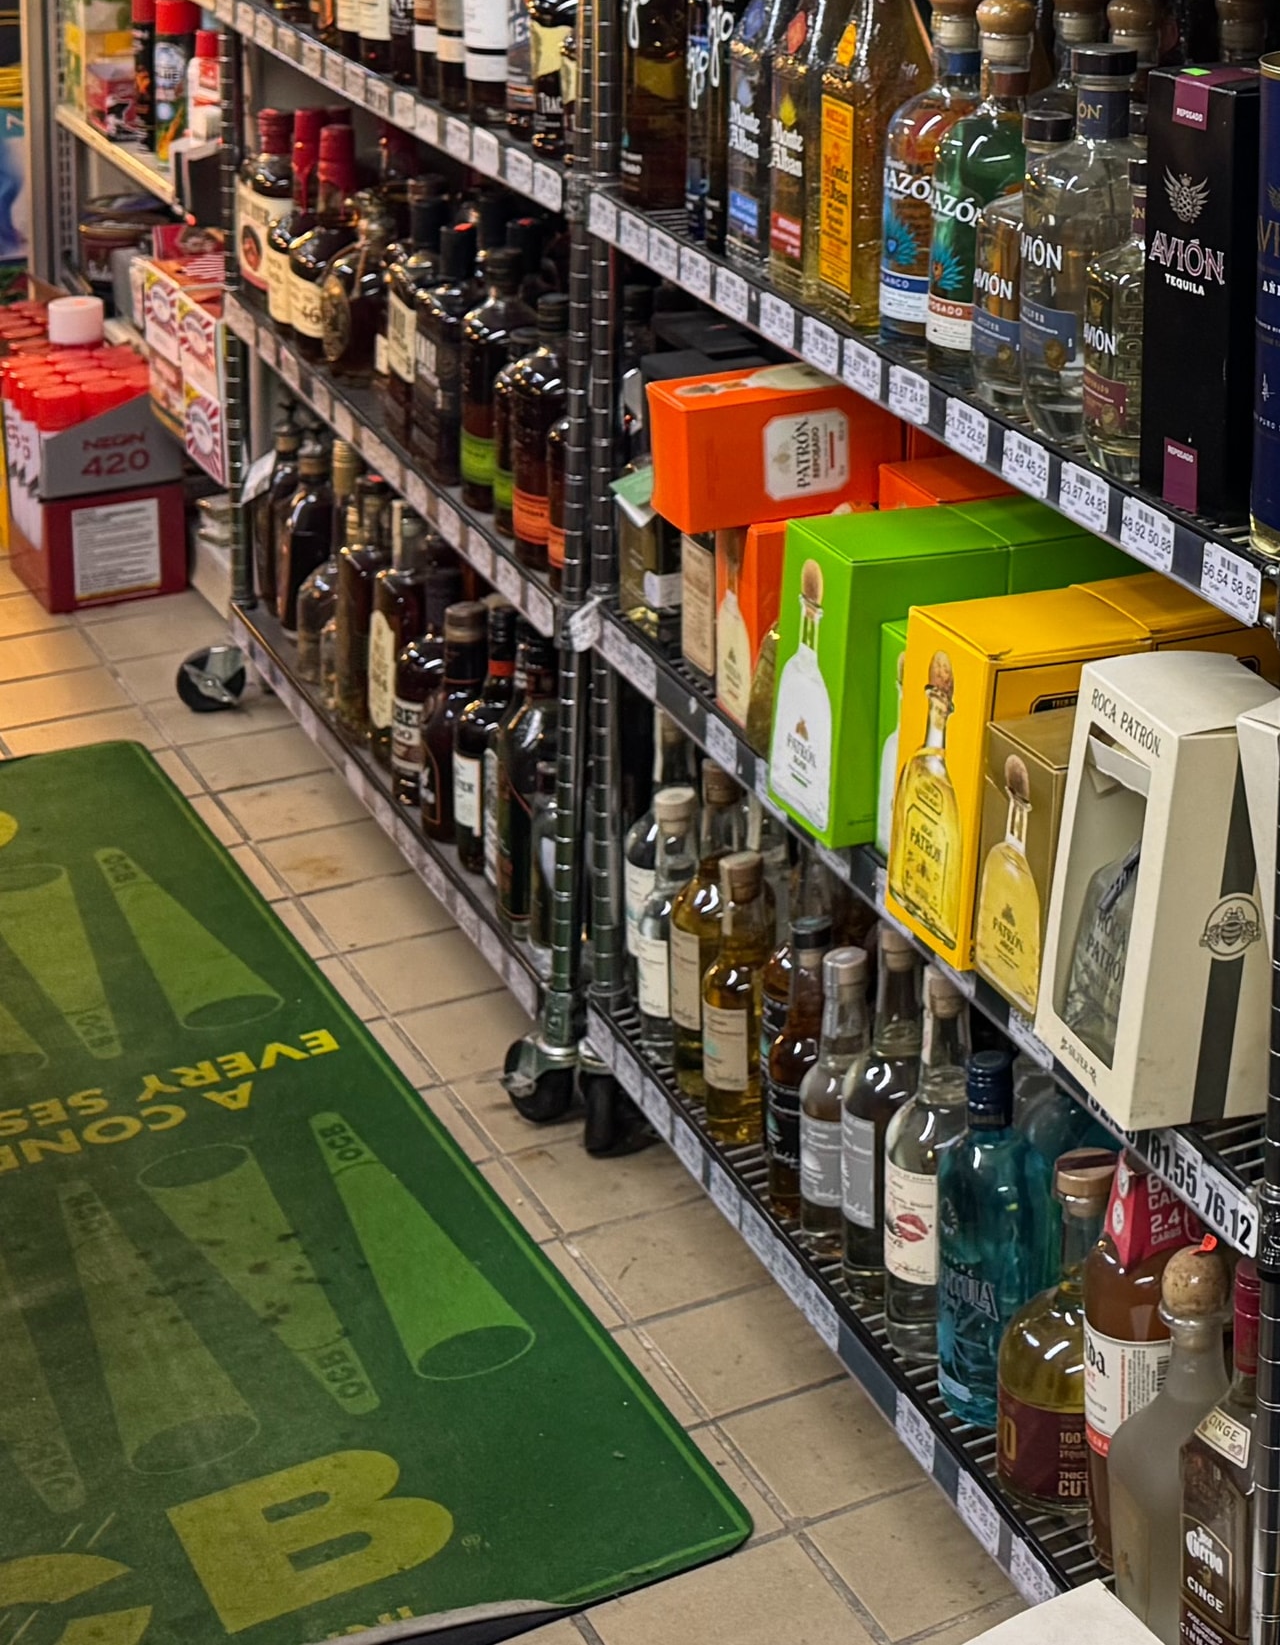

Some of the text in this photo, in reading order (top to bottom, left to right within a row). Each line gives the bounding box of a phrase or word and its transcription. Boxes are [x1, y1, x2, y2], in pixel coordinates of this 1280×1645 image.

[1149, 230, 1225, 285] AVIÓN
[1165, 274, 1205, 296] TEQUILA
[81, 448, 150, 477] 420
[796, 416, 811, 488] PATRÓN
[812, 426, 820, 479] REPOSADO
[1202, 560, 1257, 604] 56.54 58.80
[1091, 687, 1162, 758] ROCA PATRÓN
[136, 1028, 340, 1103] EVERY
[1149, 1135, 1198, 1199] 81.55
[1203, 1182, 1252, 1252] 76.12
[1187, 1575, 1225, 1614] CINGE
